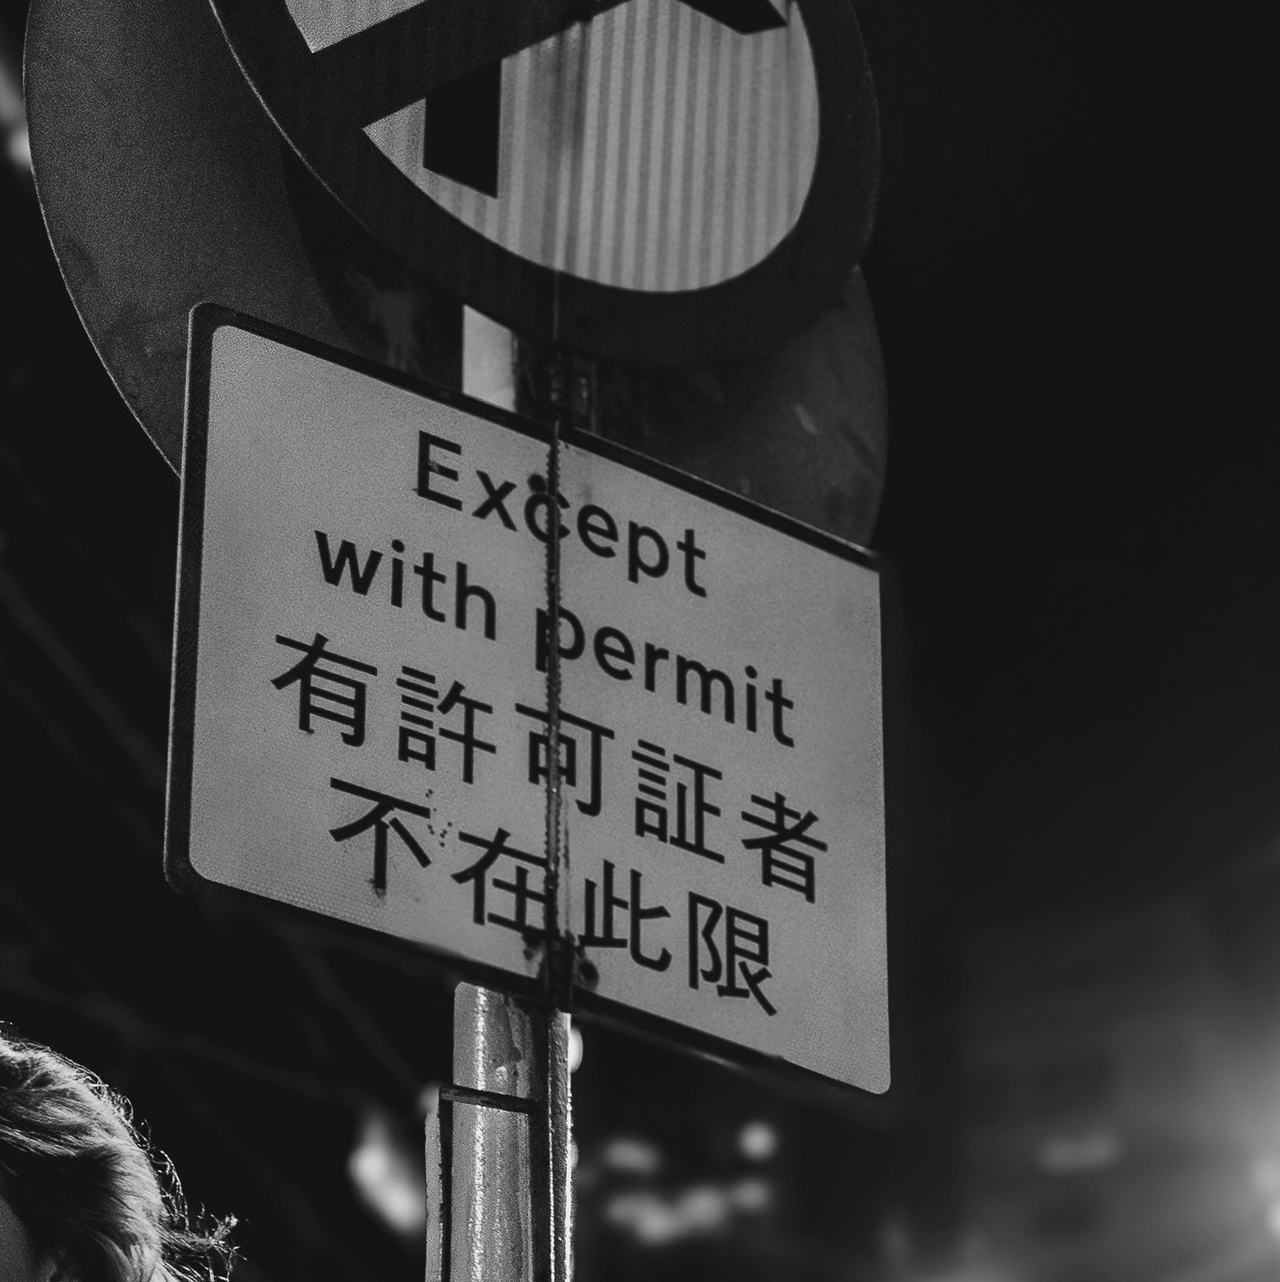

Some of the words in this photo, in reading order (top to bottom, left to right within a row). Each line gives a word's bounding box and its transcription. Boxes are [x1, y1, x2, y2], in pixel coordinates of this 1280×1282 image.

[416, 430, 707, 598] Except
[314, 529, 498, 641] with
[534, 606, 795, 748] permit
[270, 632, 828, 904] 有許可証者
[328, 776, 778, 1017] 不在此限
